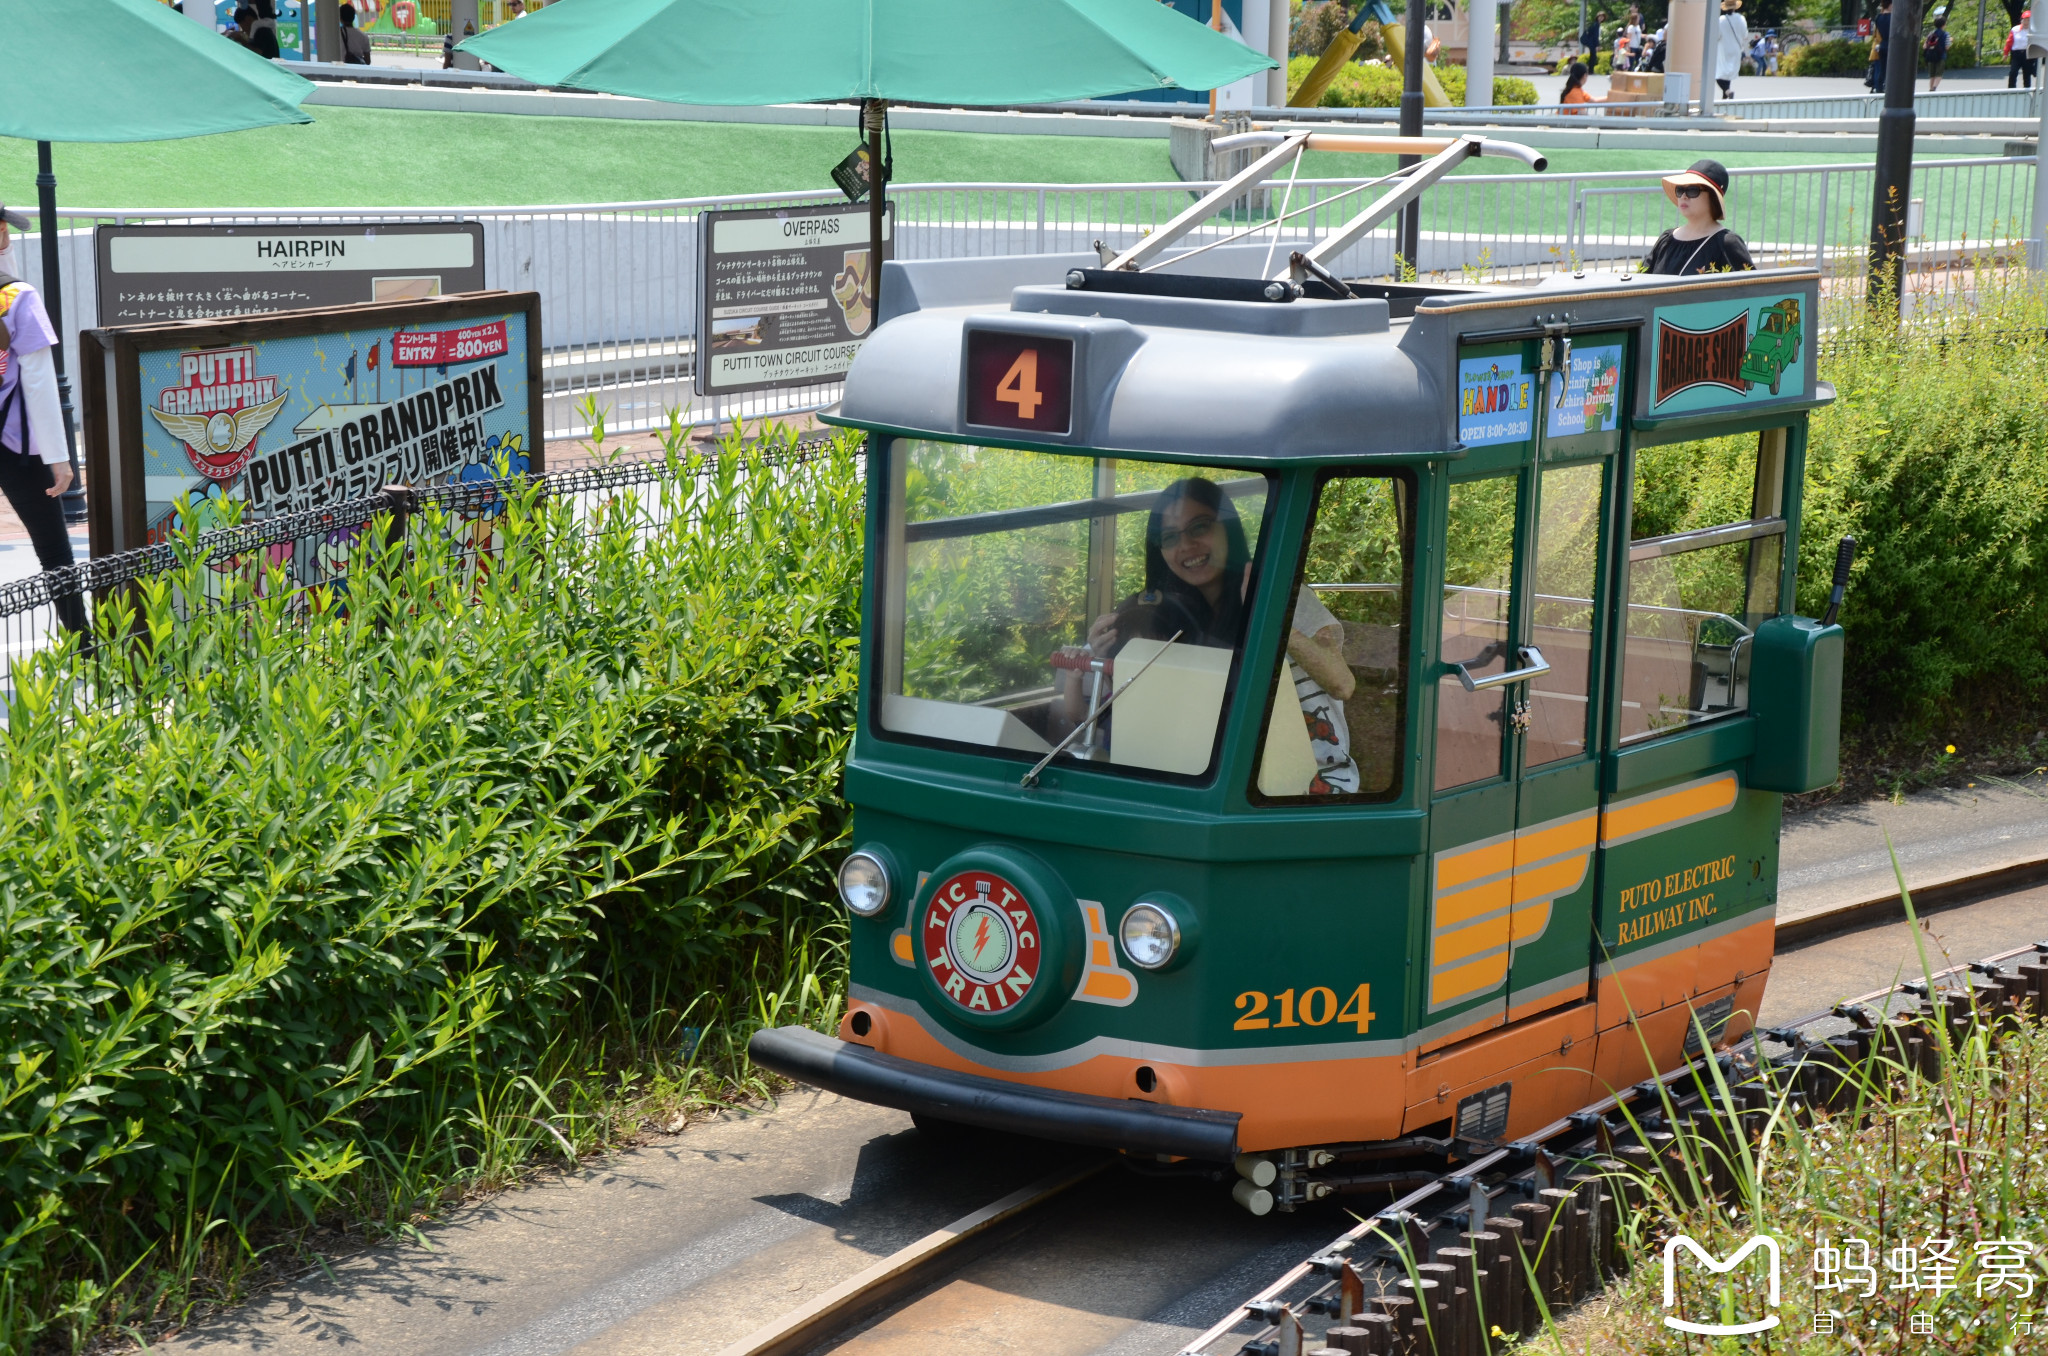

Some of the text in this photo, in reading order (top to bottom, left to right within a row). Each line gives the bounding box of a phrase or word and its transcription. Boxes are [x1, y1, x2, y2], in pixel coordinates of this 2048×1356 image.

[783, 218, 840, 237] OVERPASS
[257, 240, 345, 258] HAIRPIN
[182, 349, 253, 388] PUTTI
[399, 346, 437, 361] ENTRY
[723, 356, 751, 371] PUTTI
[754, 353, 783, 368] TOWN
[786, 350, 821, 364] CIRCUIT
[1573, 356, 1601, 373] Shop is
[1661, 323, 1744, 393] GARAGE SHOP
[162, 379, 276, 415] GRANDPRIX
[996, 349, 1042, 419] 4
[1462, 381, 1530, 416] HANDLE
[1553, 390, 1616, 409] Kchira Driving
[1560, 373, 1614, 391] vcinity in the
[249, 364, 502, 506] PUTTI GRANDPRIX
[1460, 421, 1528, 441] OPEN 8:00~20:30
[1558, 411, 1586, 426] School.
[1619, 854, 1736, 913] PUTO ELECTRIC
[929, 883, 1035, 949] TIC TAC
[1617, 893, 1718, 946] RAILWAY INC.
[929, 947, 1033, 1011] TRAIN
[1233, 982, 1376, 1035] 2104
